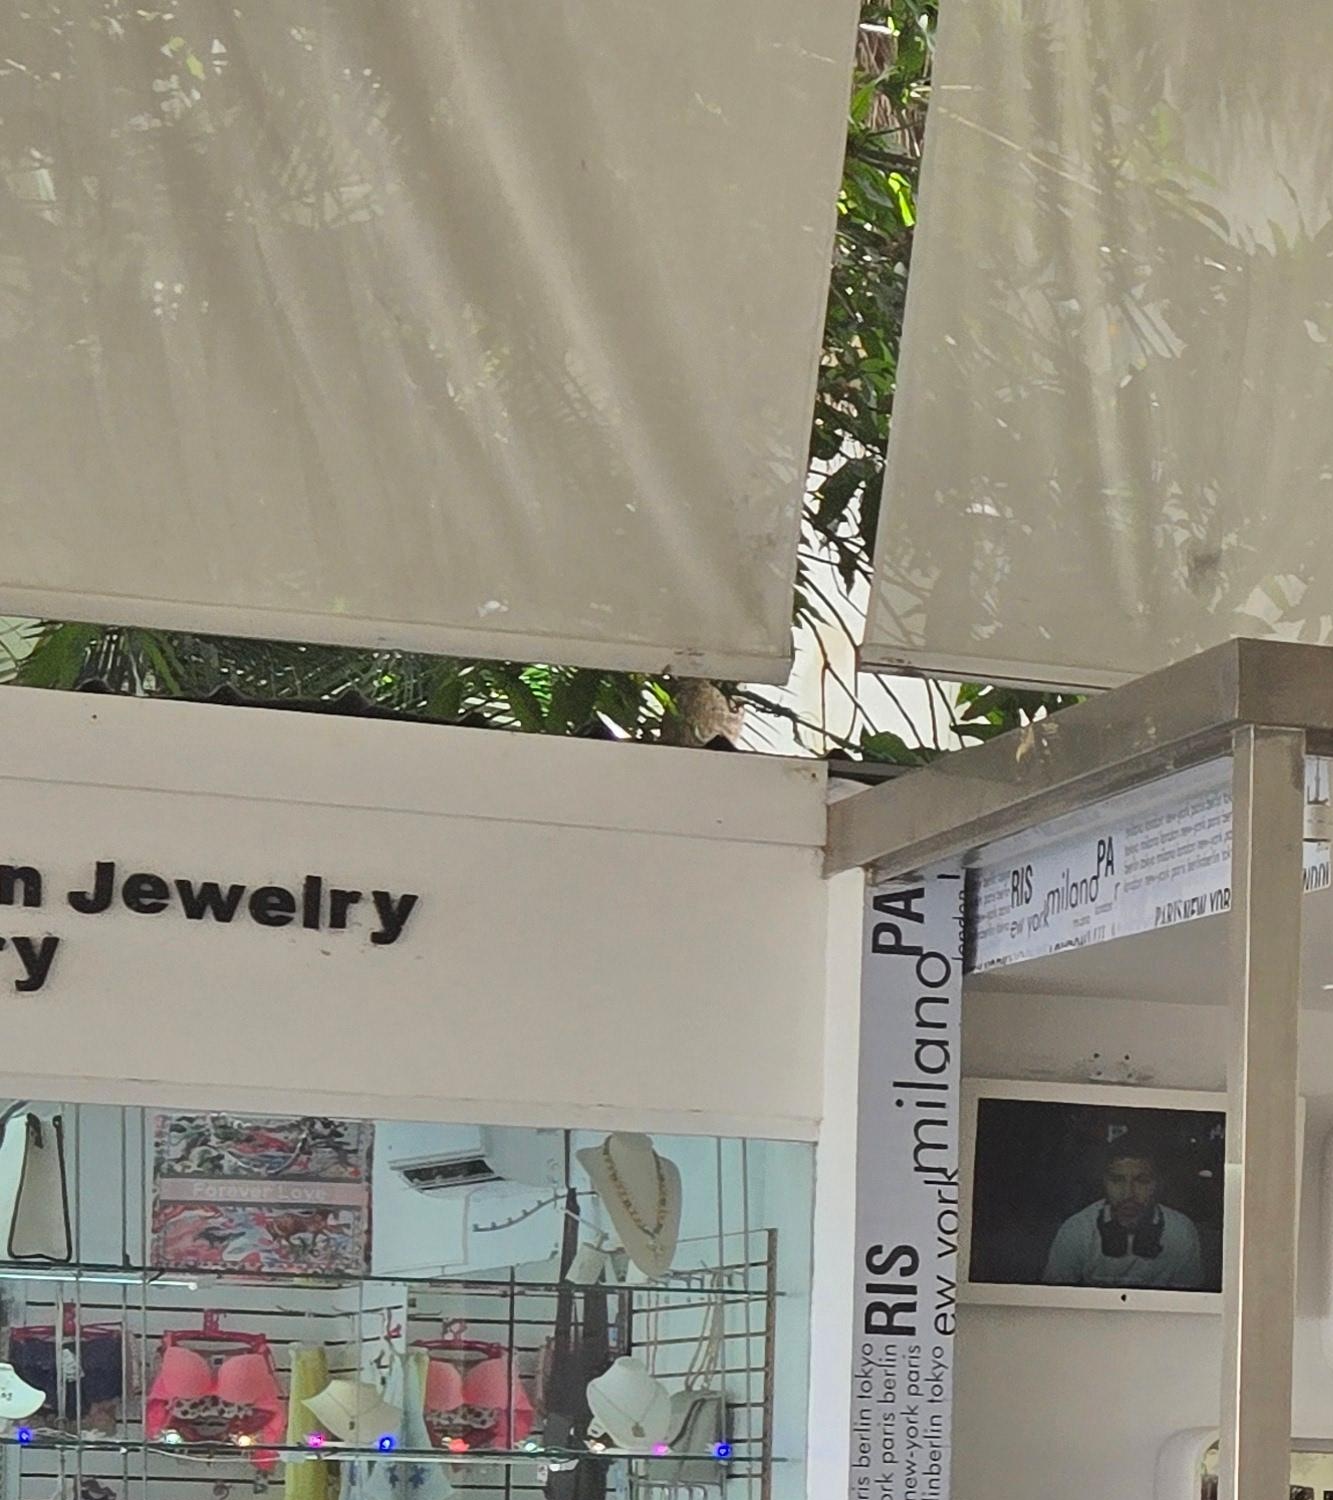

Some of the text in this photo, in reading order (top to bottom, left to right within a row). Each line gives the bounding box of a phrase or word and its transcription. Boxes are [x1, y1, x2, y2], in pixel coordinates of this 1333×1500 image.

[67, 860, 419, 945] Jewelry
[1010, 864, 1034, 909] RIS
[872, 887, 925, 956] PA
[892, 951, 952, 1175] milano
[864, 1244, 920, 1337] RIS
[854, 1343, 880, 1399] tokyo
[877, 1344, 897, 1404] berlin
[902, 1345, 924, 1397] paris
[925, 1345, 949, 1404] tokyo
[851, 1408, 872, 1469] berlin
[877, 1412, 899, 1464] paris
